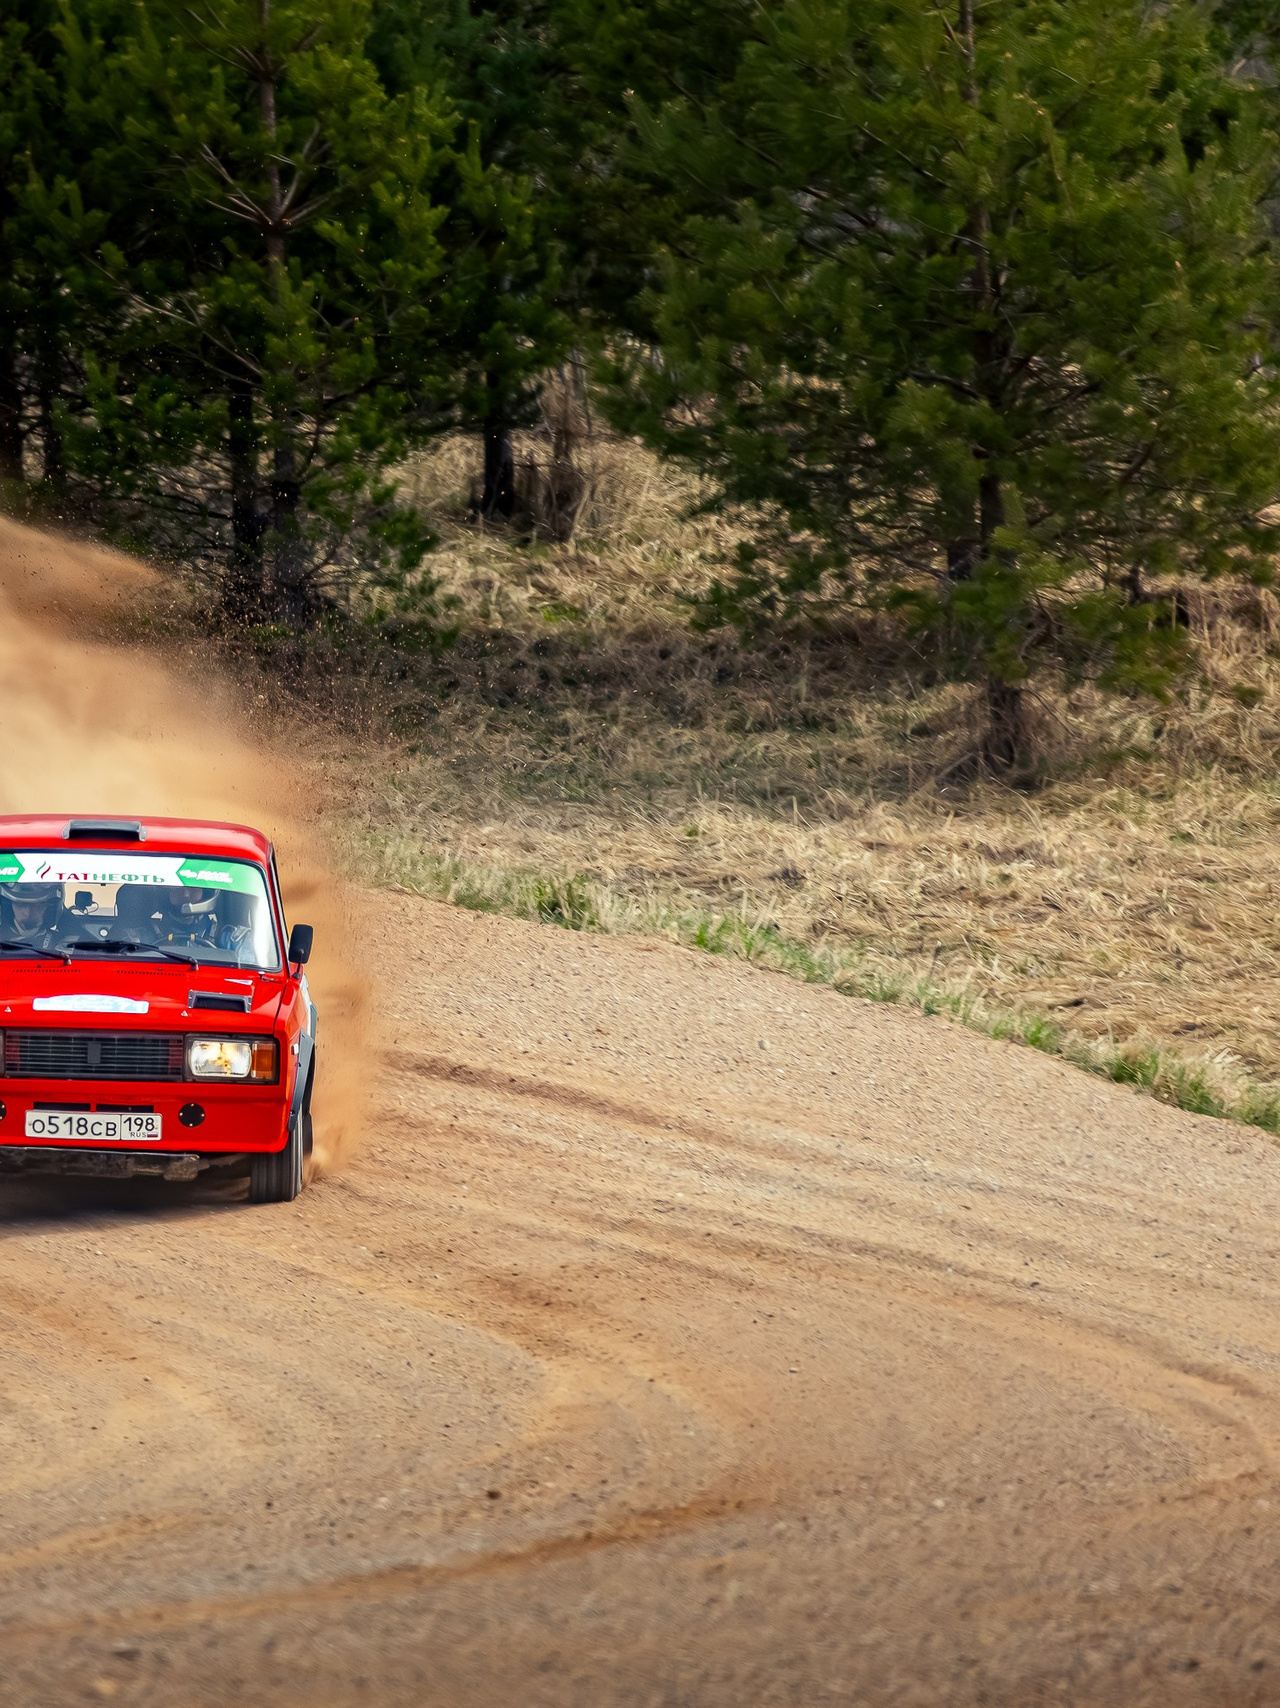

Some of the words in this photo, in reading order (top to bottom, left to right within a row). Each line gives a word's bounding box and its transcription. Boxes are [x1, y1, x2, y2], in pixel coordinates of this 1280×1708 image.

[55, 872, 165, 883] ТАТНЕФТЬ
[32, 1115, 117, 1137] О518СВ
[123, 1117, 155, 1132] 198
